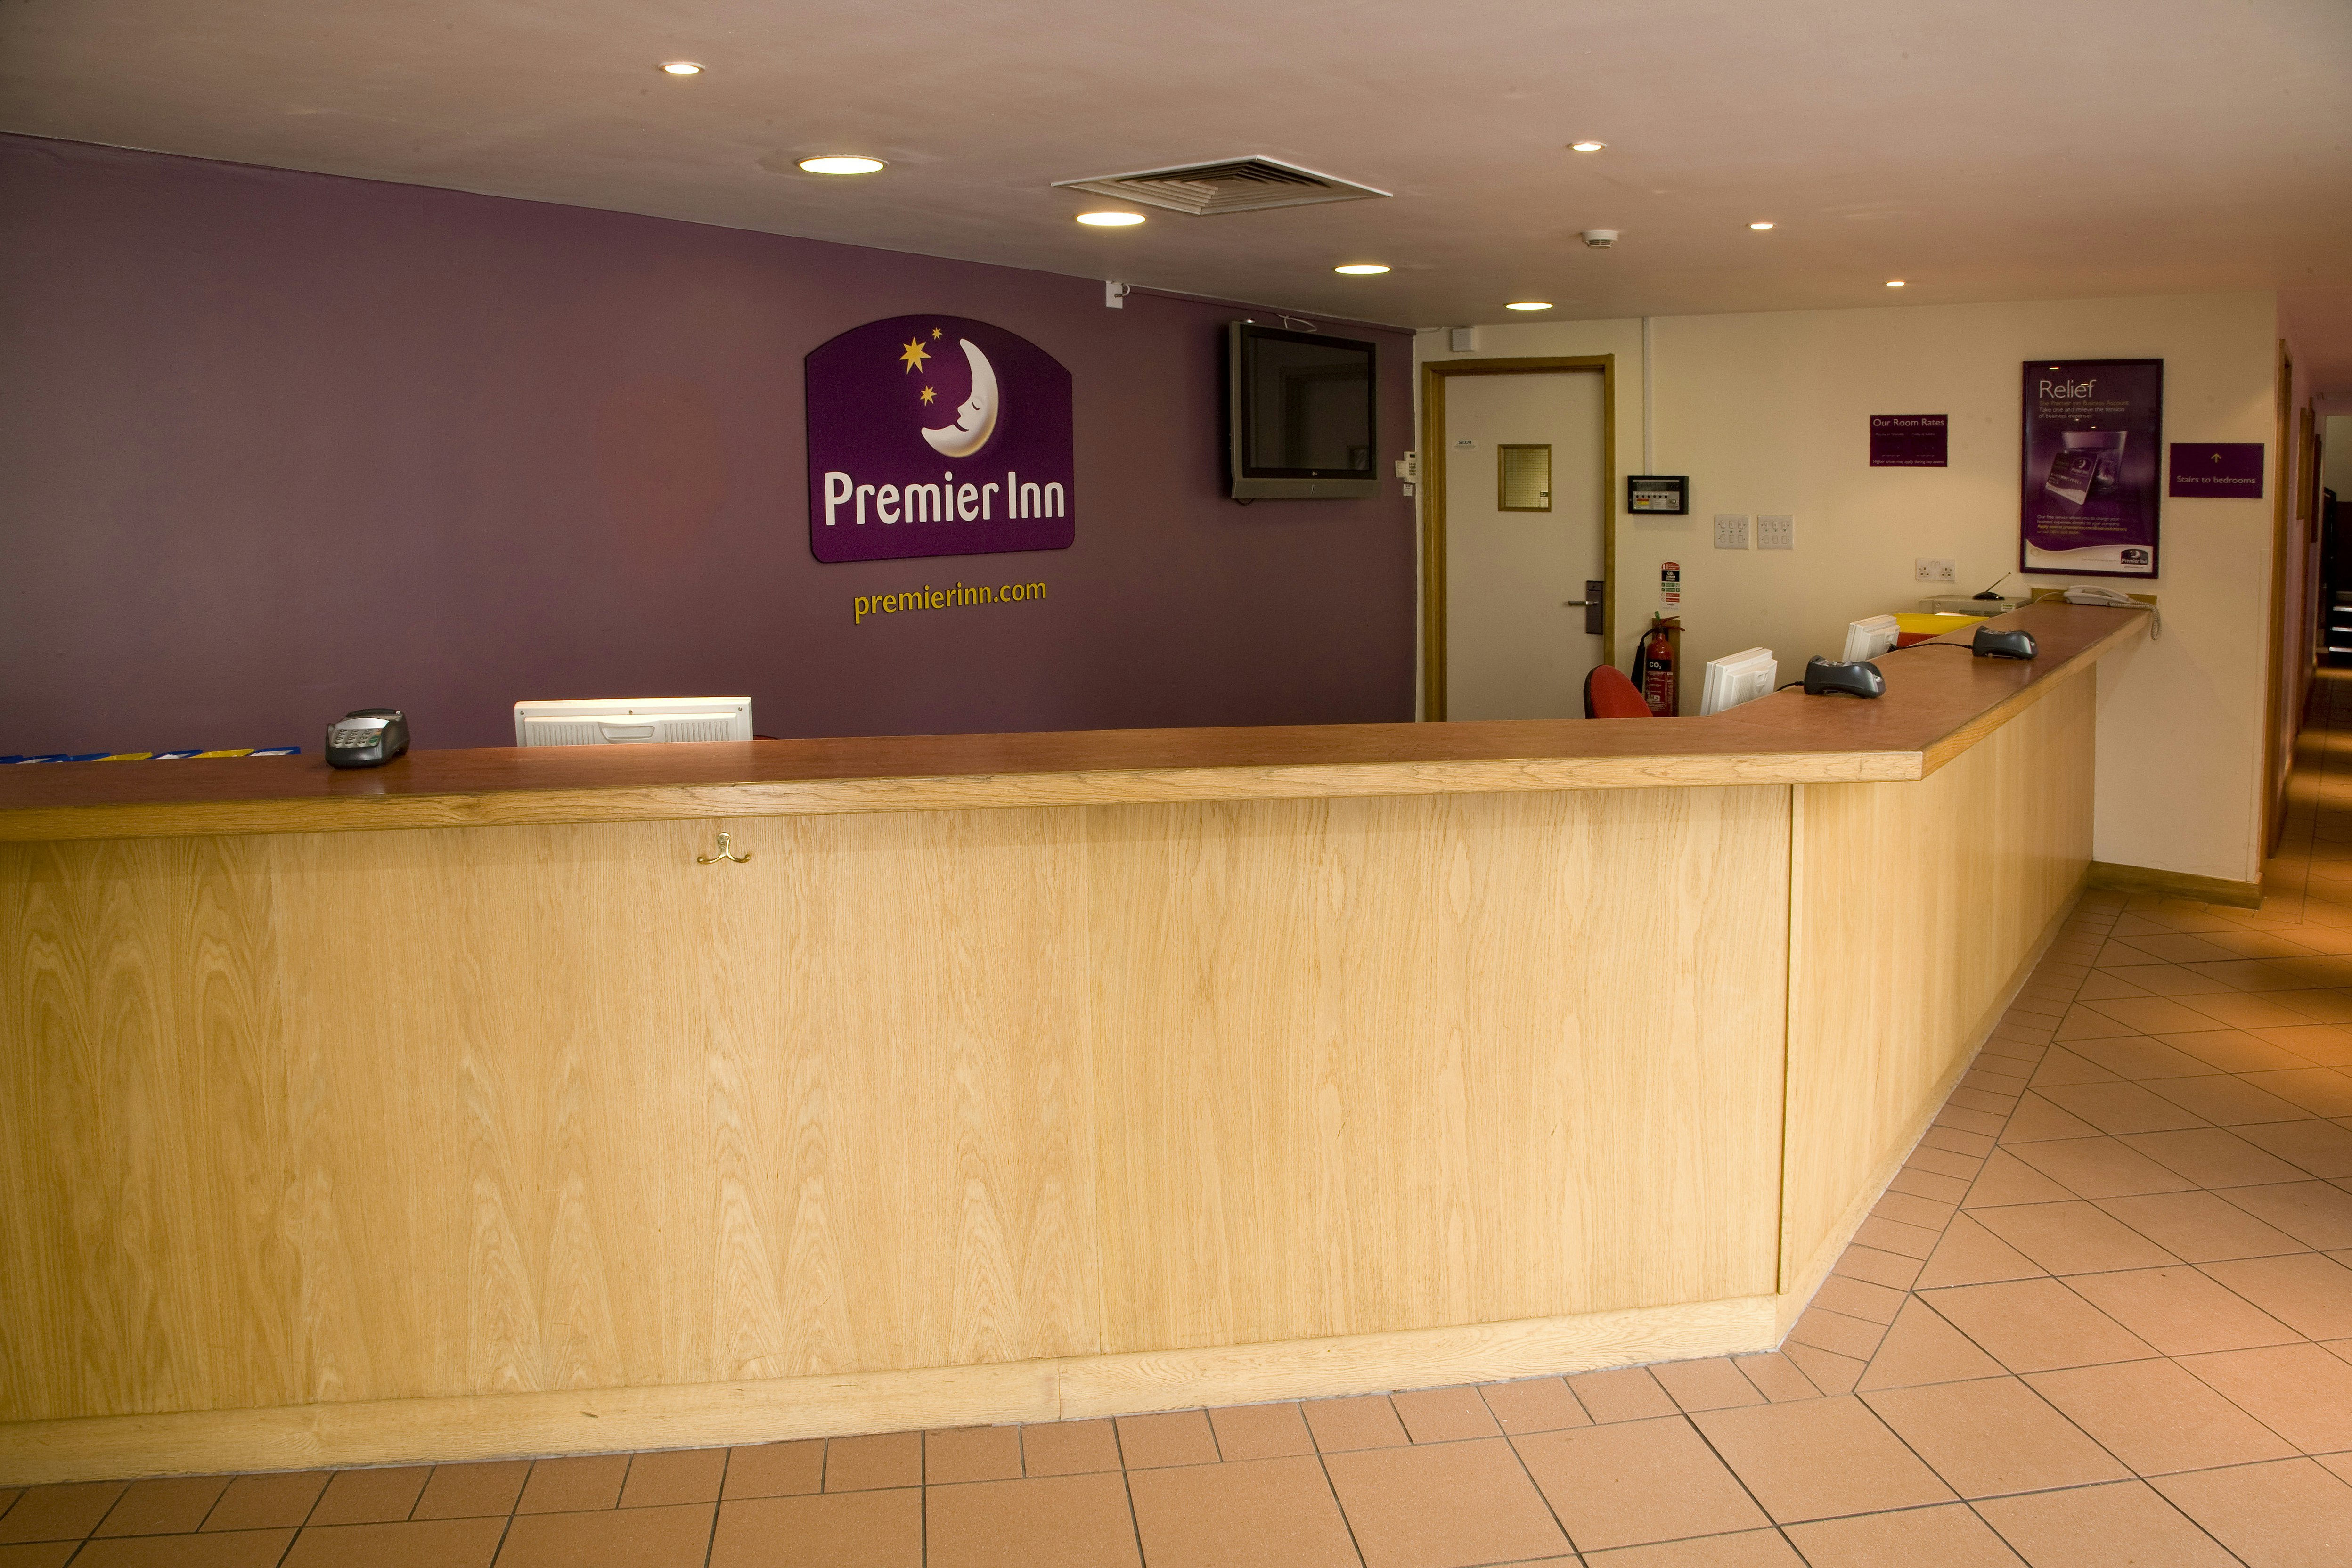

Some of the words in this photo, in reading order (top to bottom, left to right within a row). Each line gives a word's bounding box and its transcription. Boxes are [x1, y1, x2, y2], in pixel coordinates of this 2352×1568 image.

[2039, 379, 2097, 398] Relief
[2213, 476, 2256, 484] bedrooms
[825, 471, 999, 526] Premier
[1008, 471, 1065, 519] Inn
[854, 582, 1047, 625] premierinn.com
